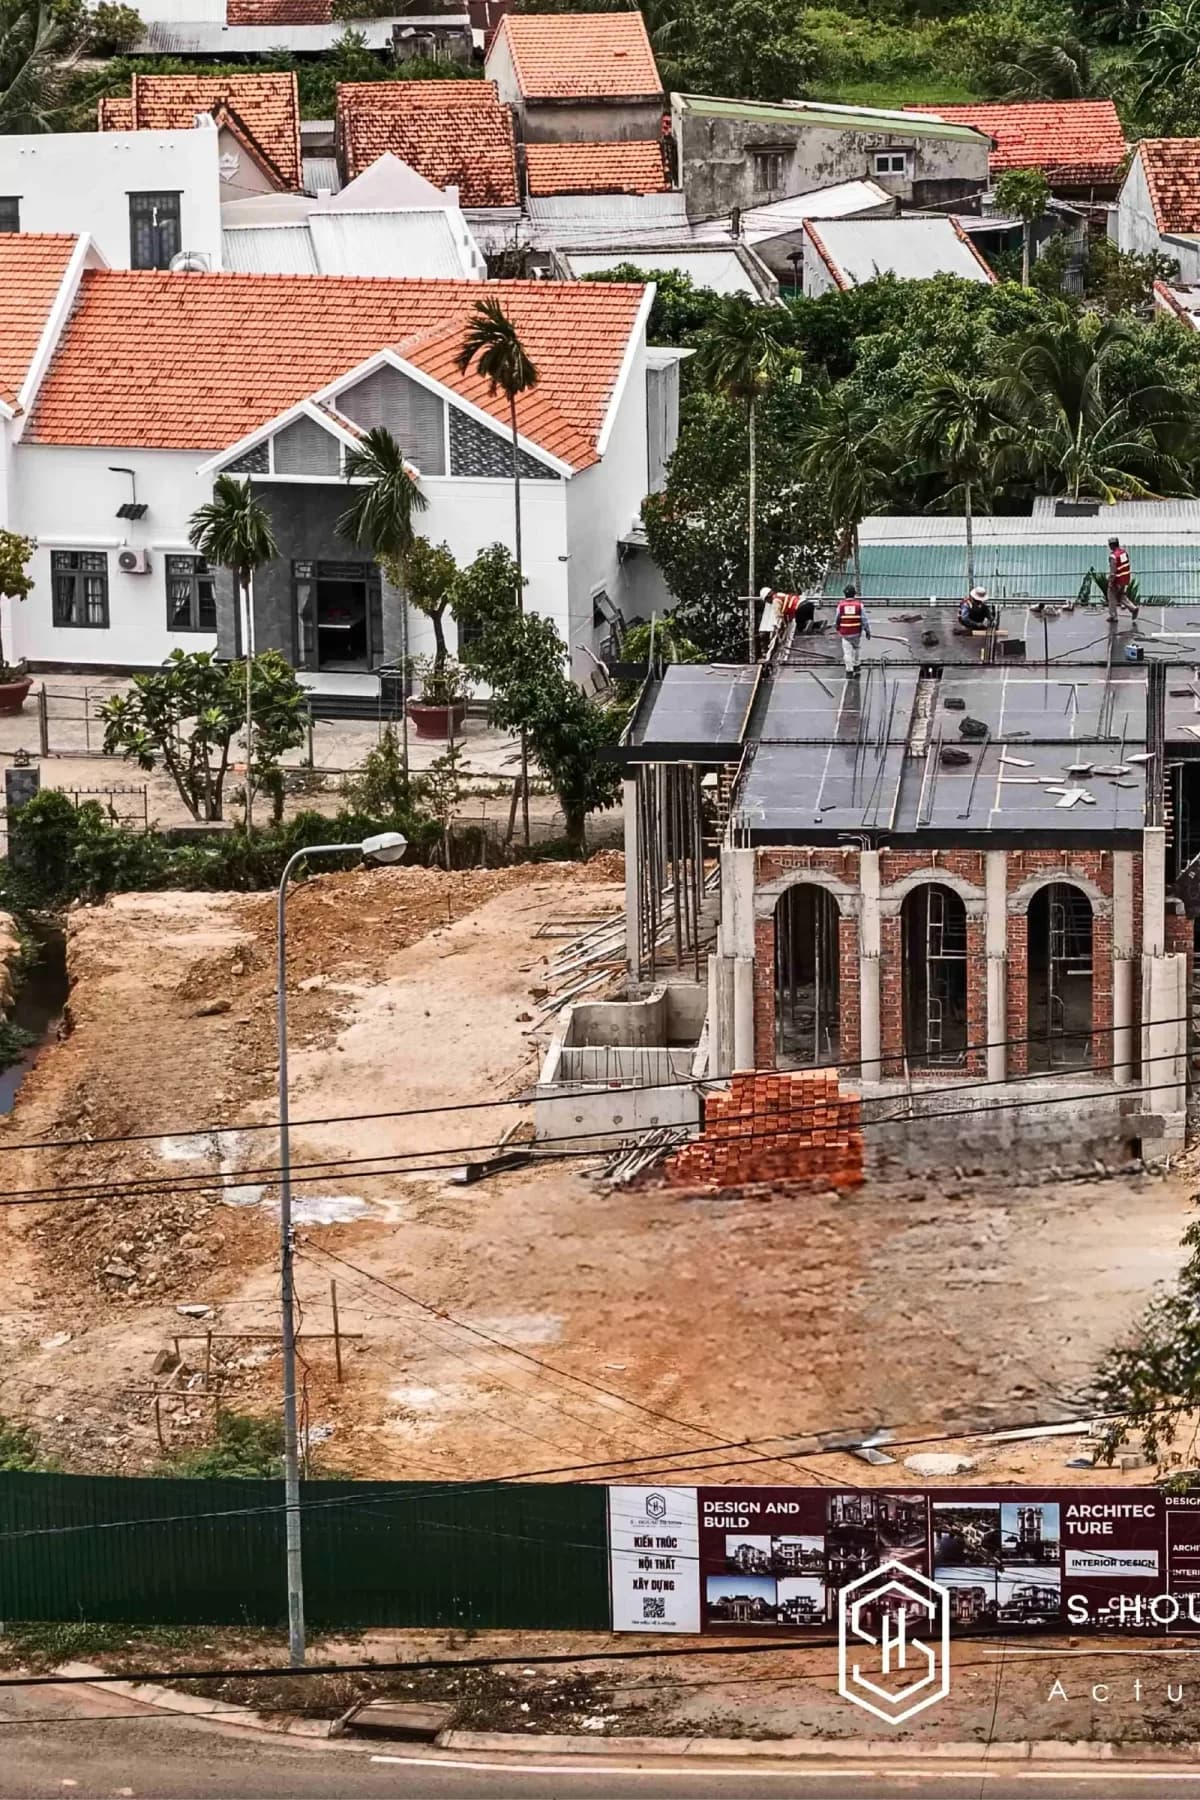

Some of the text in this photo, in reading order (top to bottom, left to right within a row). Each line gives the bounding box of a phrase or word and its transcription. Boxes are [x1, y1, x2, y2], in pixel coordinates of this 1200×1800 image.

[703, 1501, 800, 1514] DESIGN AND
[1066, 1504, 1156, 1518] ARCHITEC
[704, 1517, 750, 1528] BUILD
[1066, 1521, 1114, 1535] TURE
[1072, 1559, 1155, 1567] INTERIOR DESIGN
